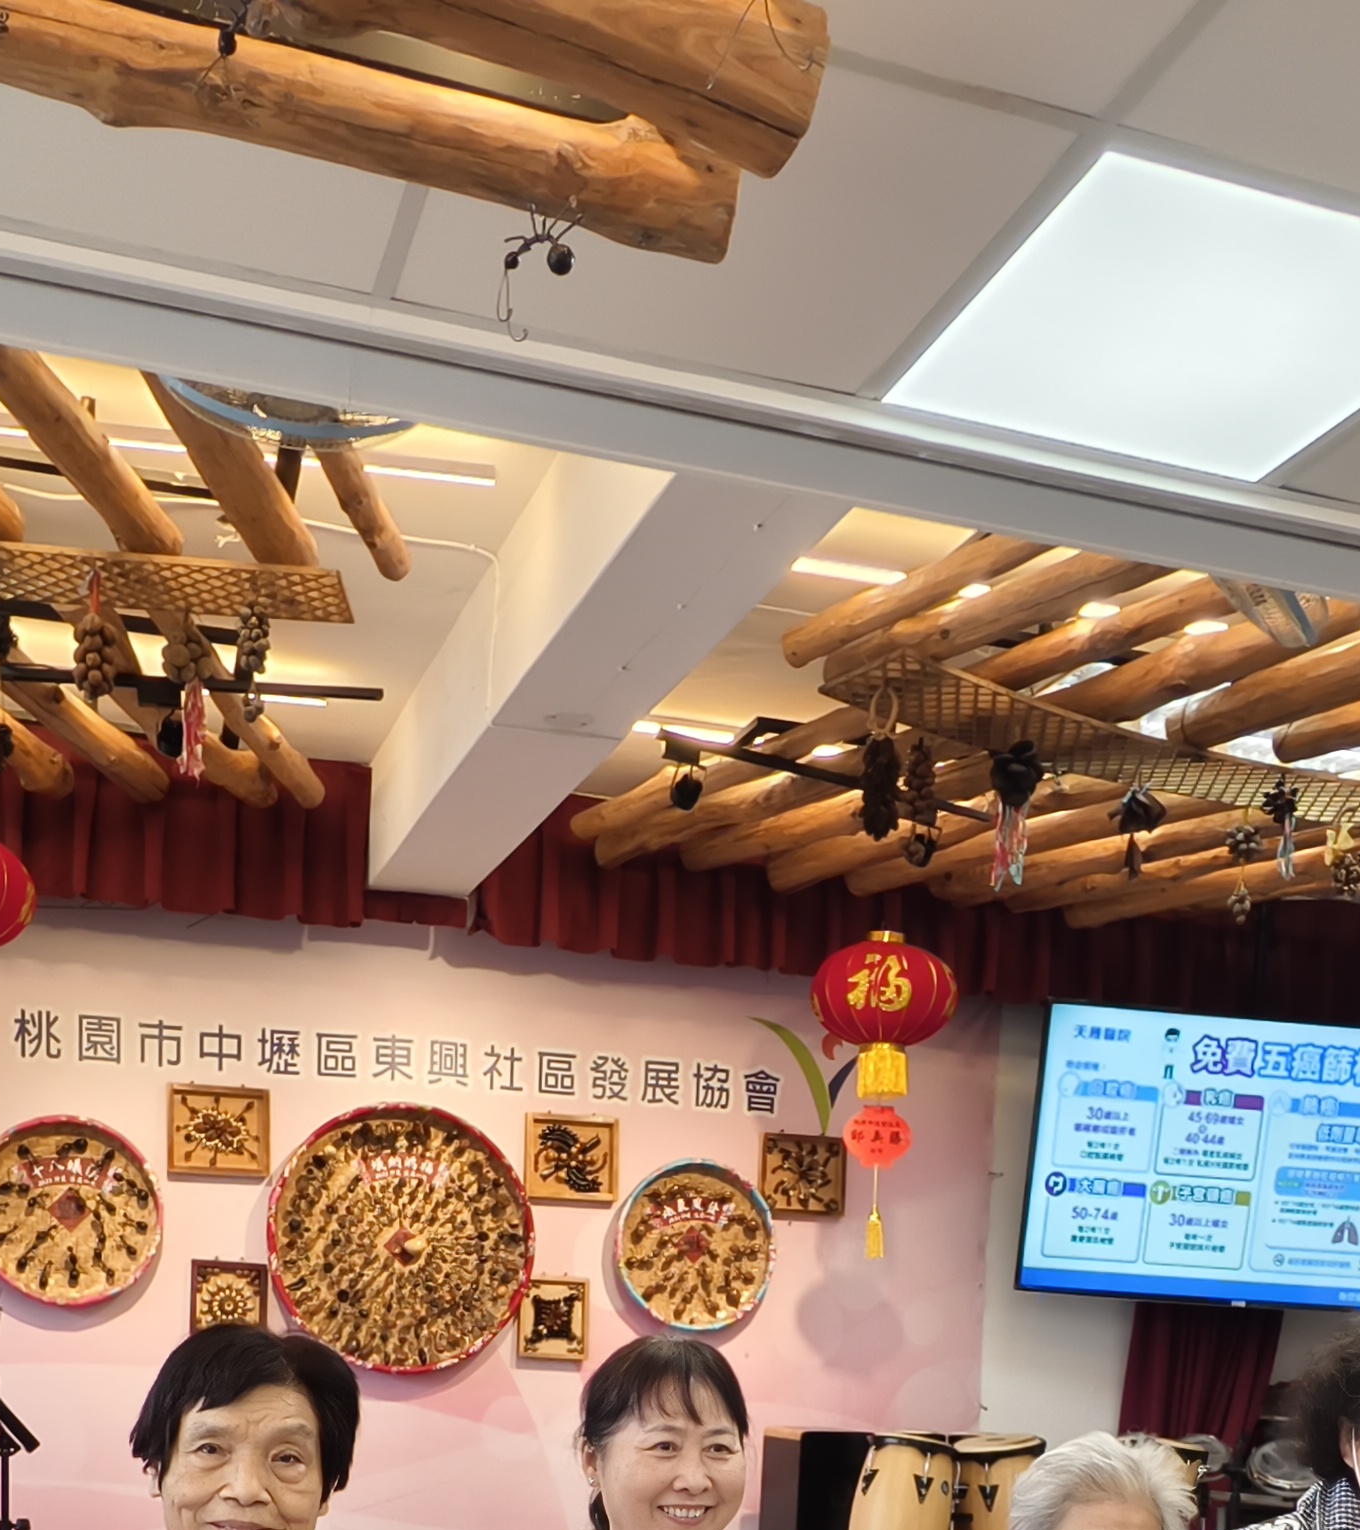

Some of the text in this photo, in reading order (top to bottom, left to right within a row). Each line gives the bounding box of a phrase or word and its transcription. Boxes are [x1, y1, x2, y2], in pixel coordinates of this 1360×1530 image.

[846, 953, 912, 1012] 福
[13, 1009, 781, 1114] 桃園市中壢區東興社區發展協會
